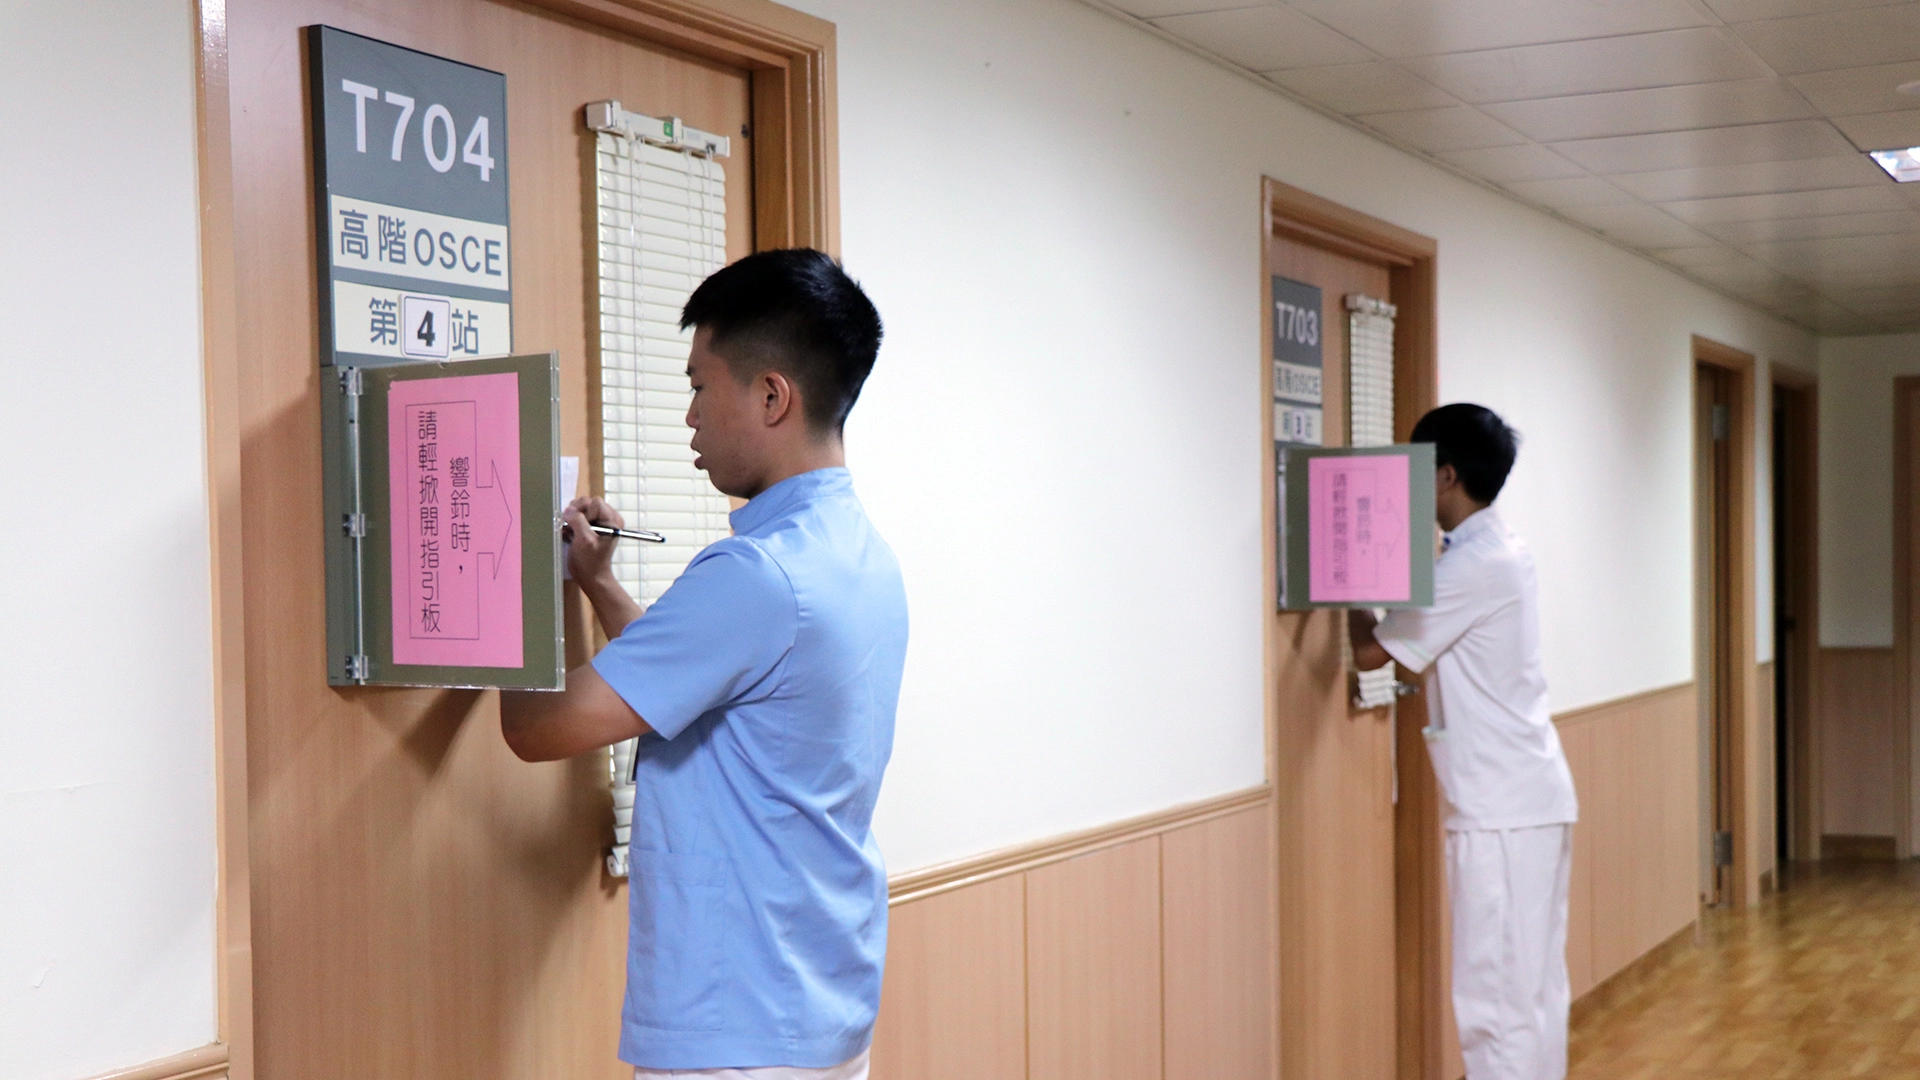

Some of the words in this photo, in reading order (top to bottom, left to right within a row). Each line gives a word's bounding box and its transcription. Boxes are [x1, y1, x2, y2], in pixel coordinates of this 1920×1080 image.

[342, 79, 495, 182] T704
[339, 209, 502, 277] 高階OSCE
[369, 296, 479, 355] 第4站
[1276, 301, 1319, 346] T703
[418, 410, 441, 633] 請輕掀開指引板
